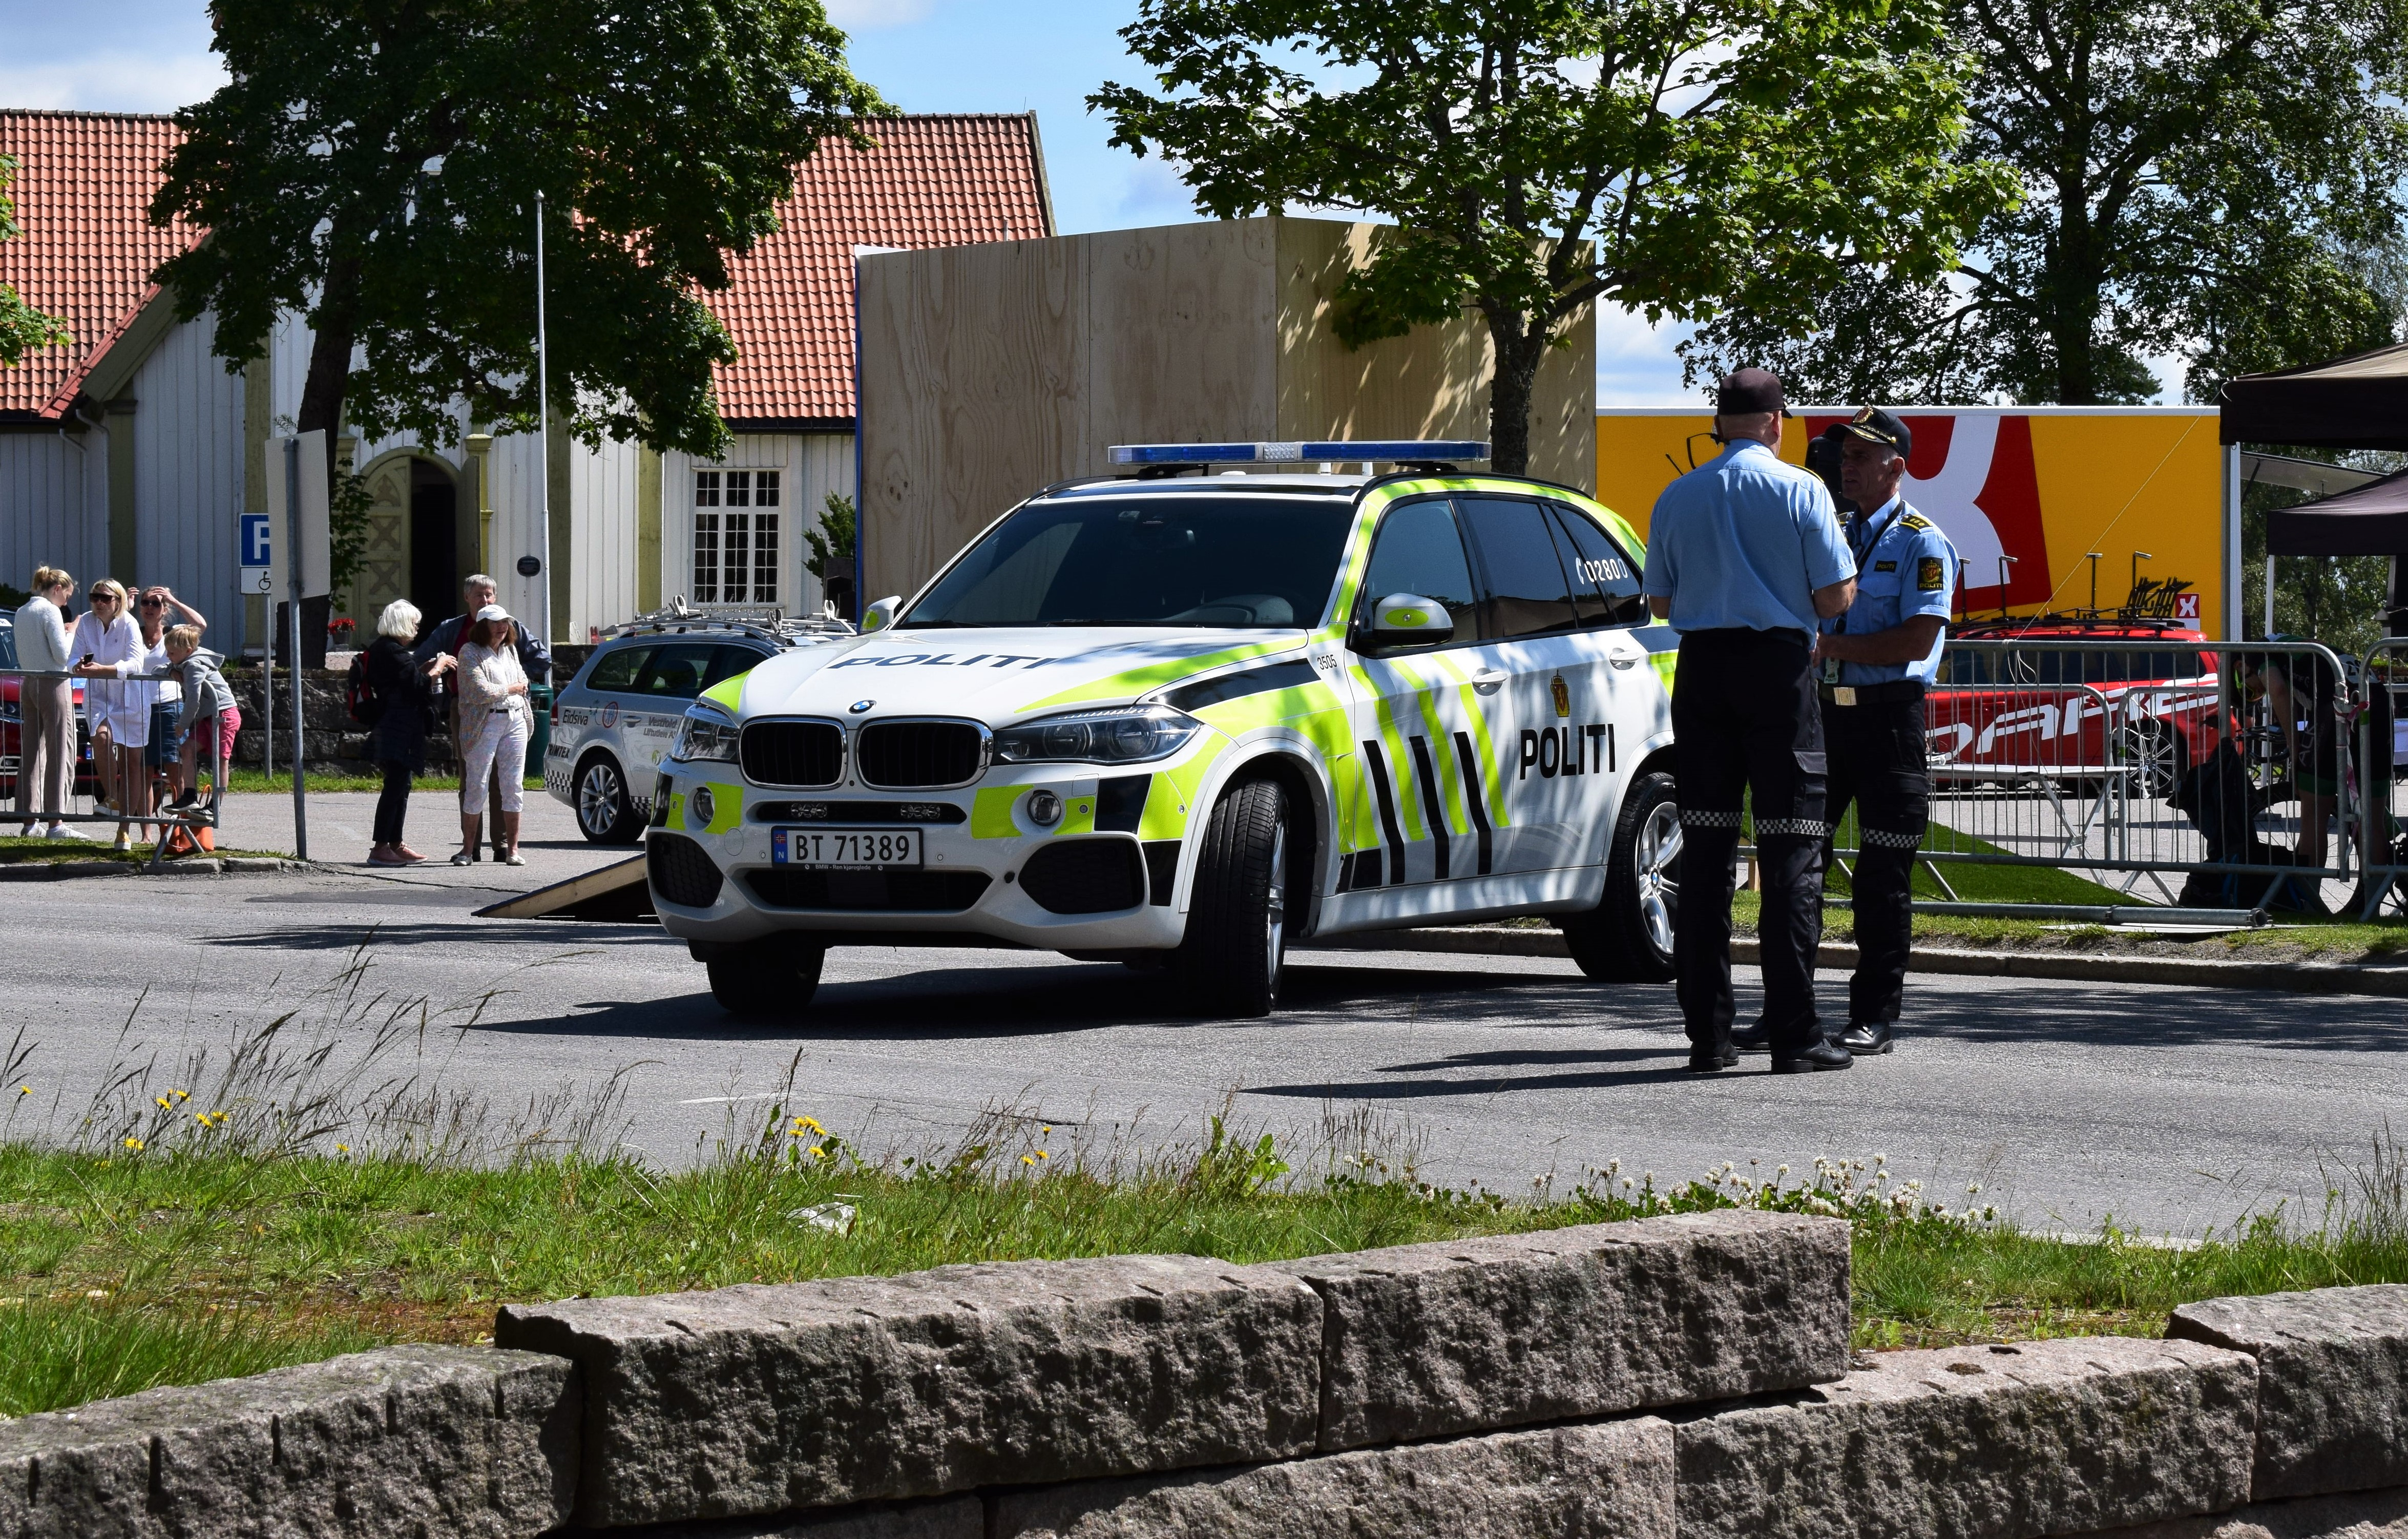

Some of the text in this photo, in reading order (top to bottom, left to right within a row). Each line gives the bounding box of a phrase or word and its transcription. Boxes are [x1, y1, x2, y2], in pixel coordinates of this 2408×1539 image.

[1584, 558, 1628, 582] 02800
[2179, 596, 2197, 616] X
[827, 654, 1059, 669] POLITI
[1317, 654, 1337, 670] 3505
[562, 709, 589, 725] Eidsiva
[648, 716, 678, 729] Vestfold
[1519, 723, 1616, 780] POLITI
[796, 835, 910, 861] BT 71389
